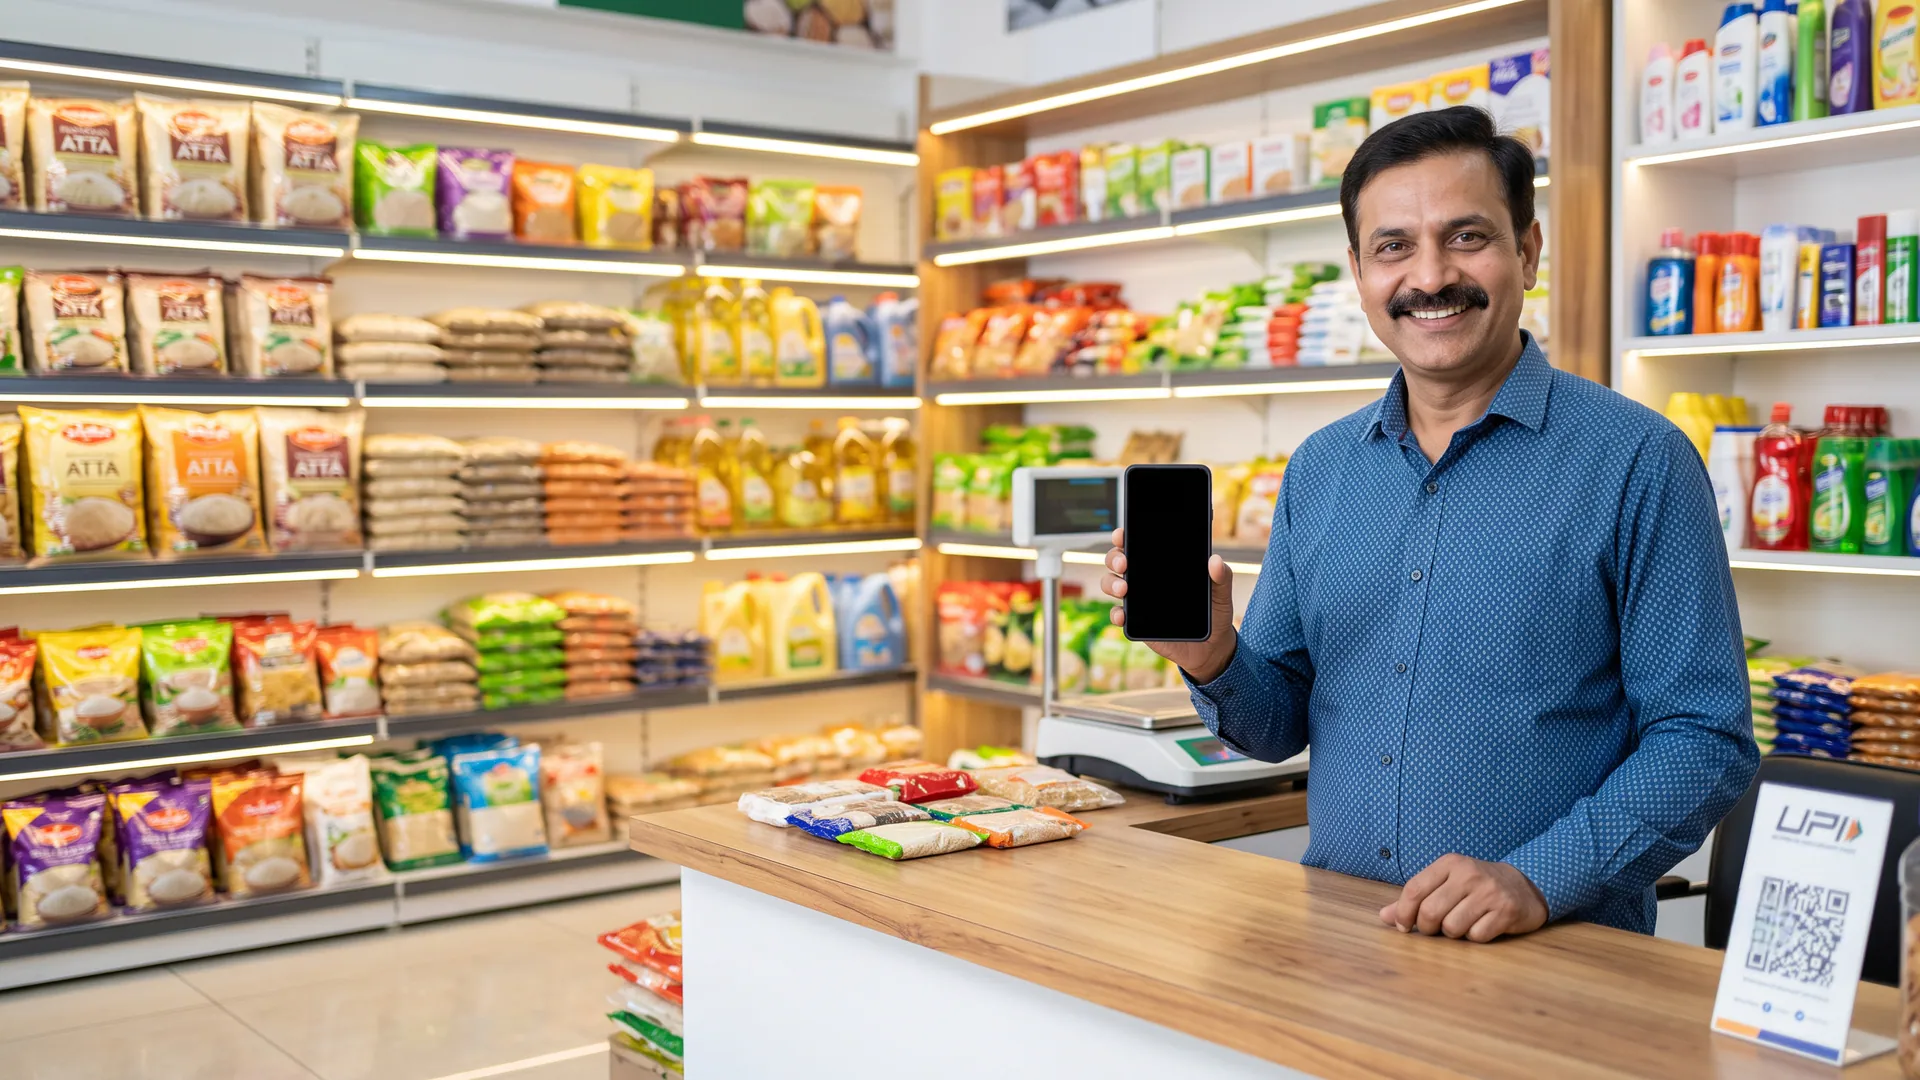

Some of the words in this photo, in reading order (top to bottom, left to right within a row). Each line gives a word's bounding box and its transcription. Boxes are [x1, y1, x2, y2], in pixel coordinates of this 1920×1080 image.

[60, 134, 114, 155] ATTA
[176, 142, 228, 163] ATTA
[288, 151, 339, 171] ATTA
[66, 459, 119, 477] ATTA
[187, 458, 239, 476] ATTA
[294, 459, 345, 477] ATTA
[1776, 805, 1849, 842] UPI
